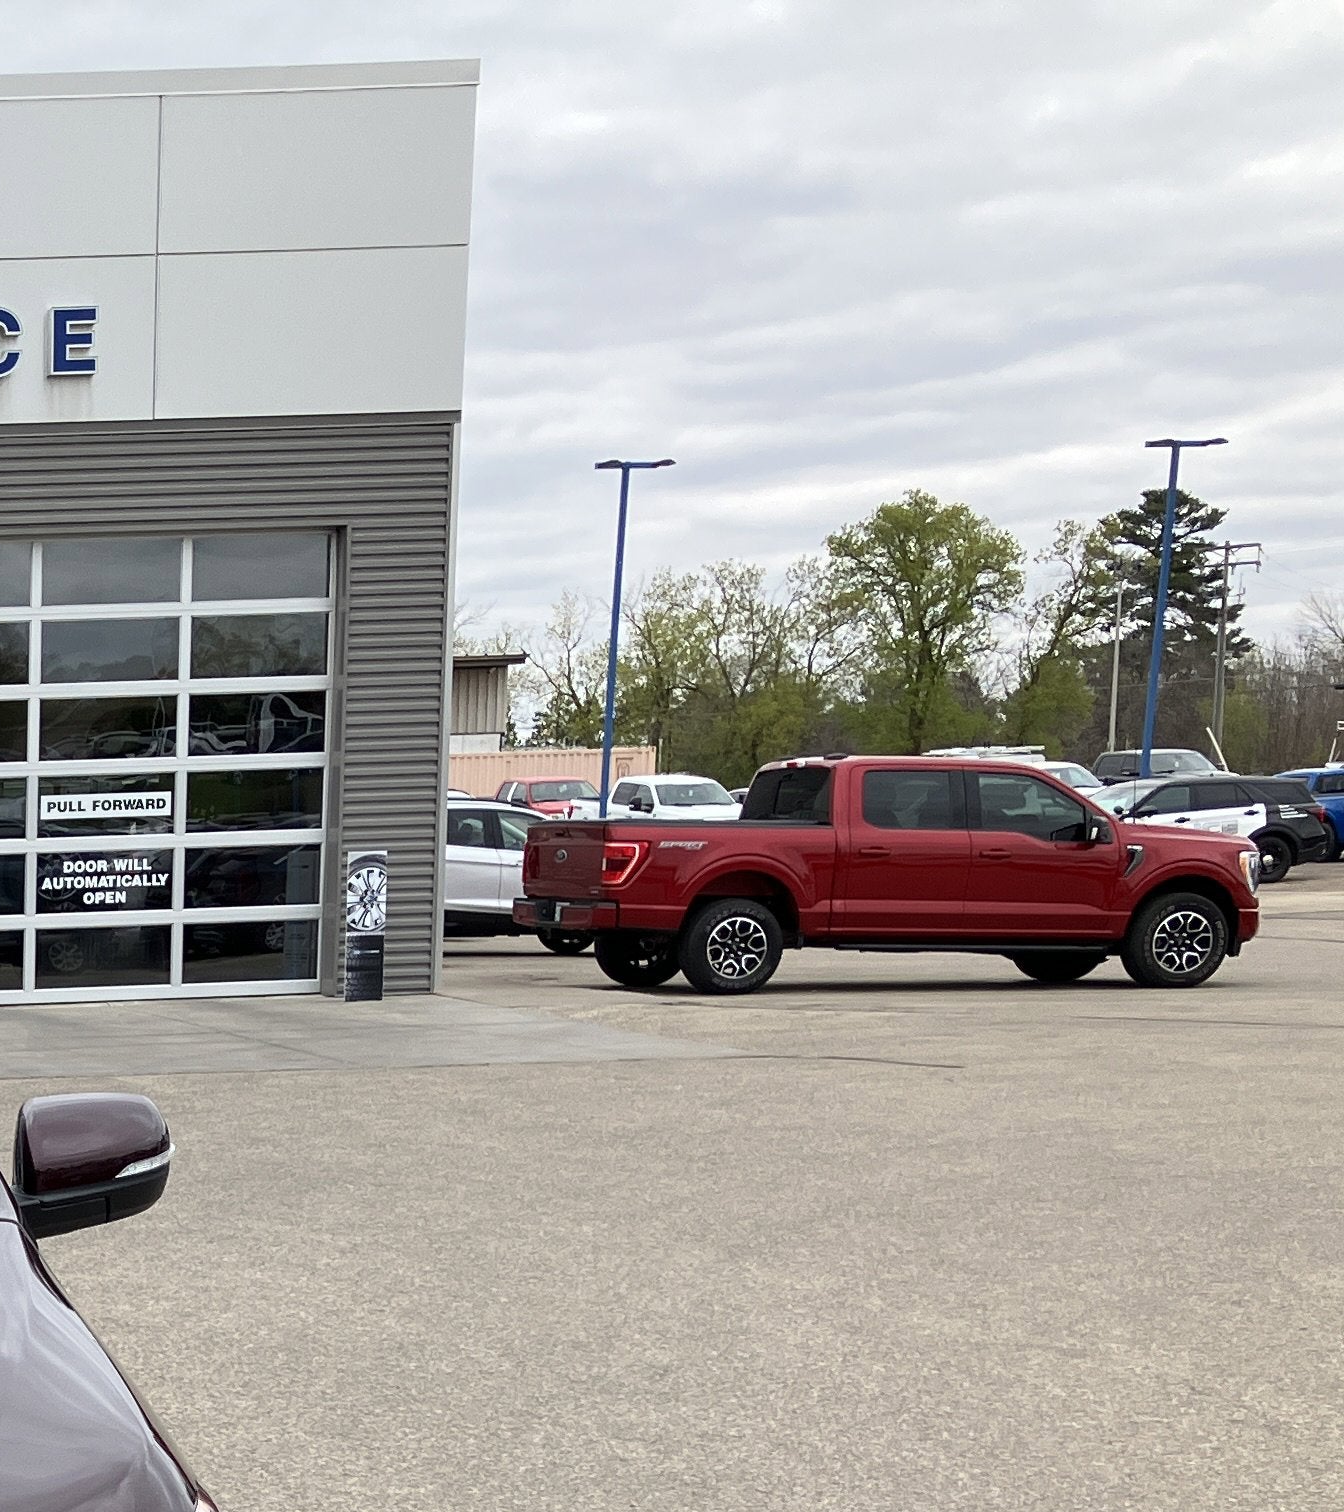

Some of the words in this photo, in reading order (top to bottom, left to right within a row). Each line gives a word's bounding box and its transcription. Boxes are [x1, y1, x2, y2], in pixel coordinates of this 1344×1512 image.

[47, 801, 87, 813] PULL
[92, 798, 167, 811] FORWARD
[63, 860, 108, 873] DOOR
[113, 858, 152, 871] WILL
[41, 873, 170, 890] AUTOMATICALLY
[83, 891, 127, 904] OPEN
